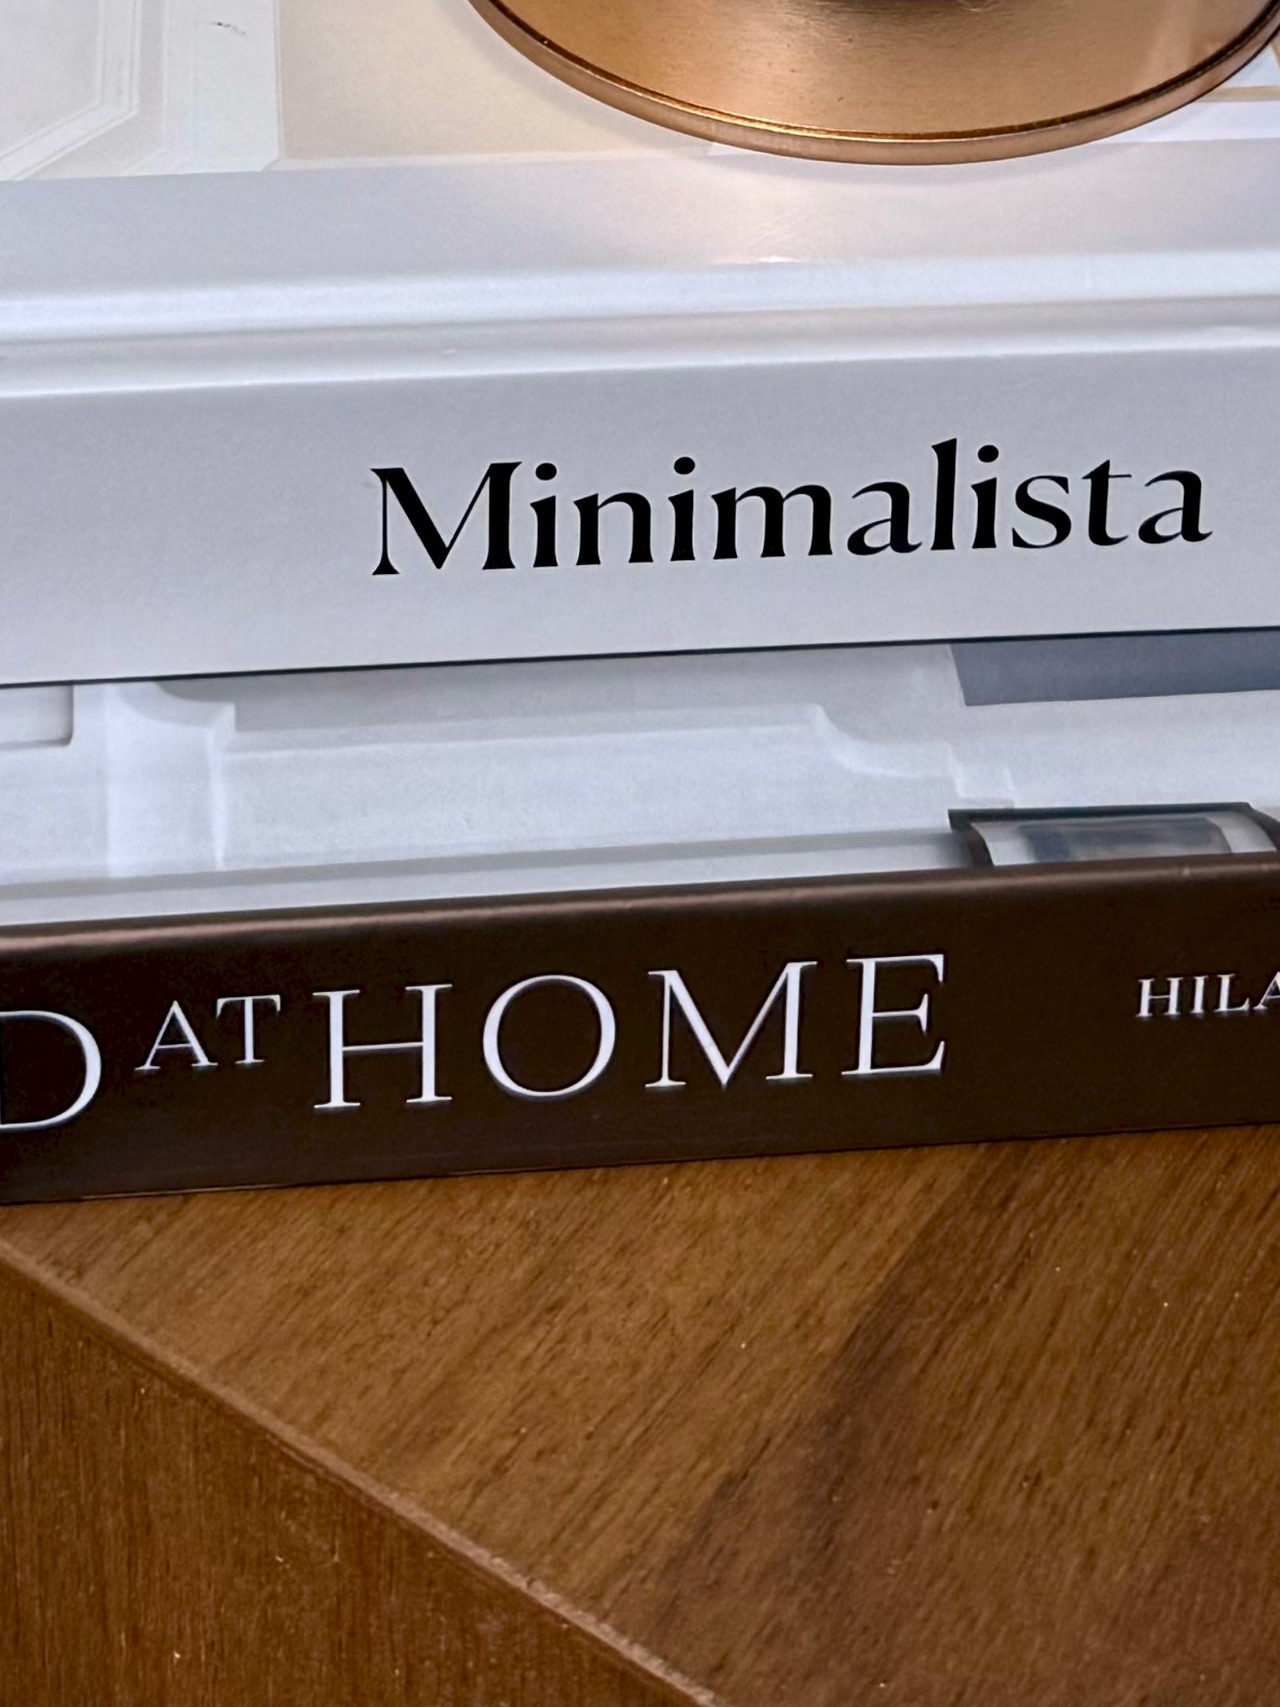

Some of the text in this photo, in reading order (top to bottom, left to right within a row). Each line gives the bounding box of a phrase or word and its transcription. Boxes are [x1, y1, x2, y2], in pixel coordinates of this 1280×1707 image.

[370, 437, 1213, 576] Minimalista
[135, 993, 282, 1072] AT
[312, 952, 946, 1110] HOME
